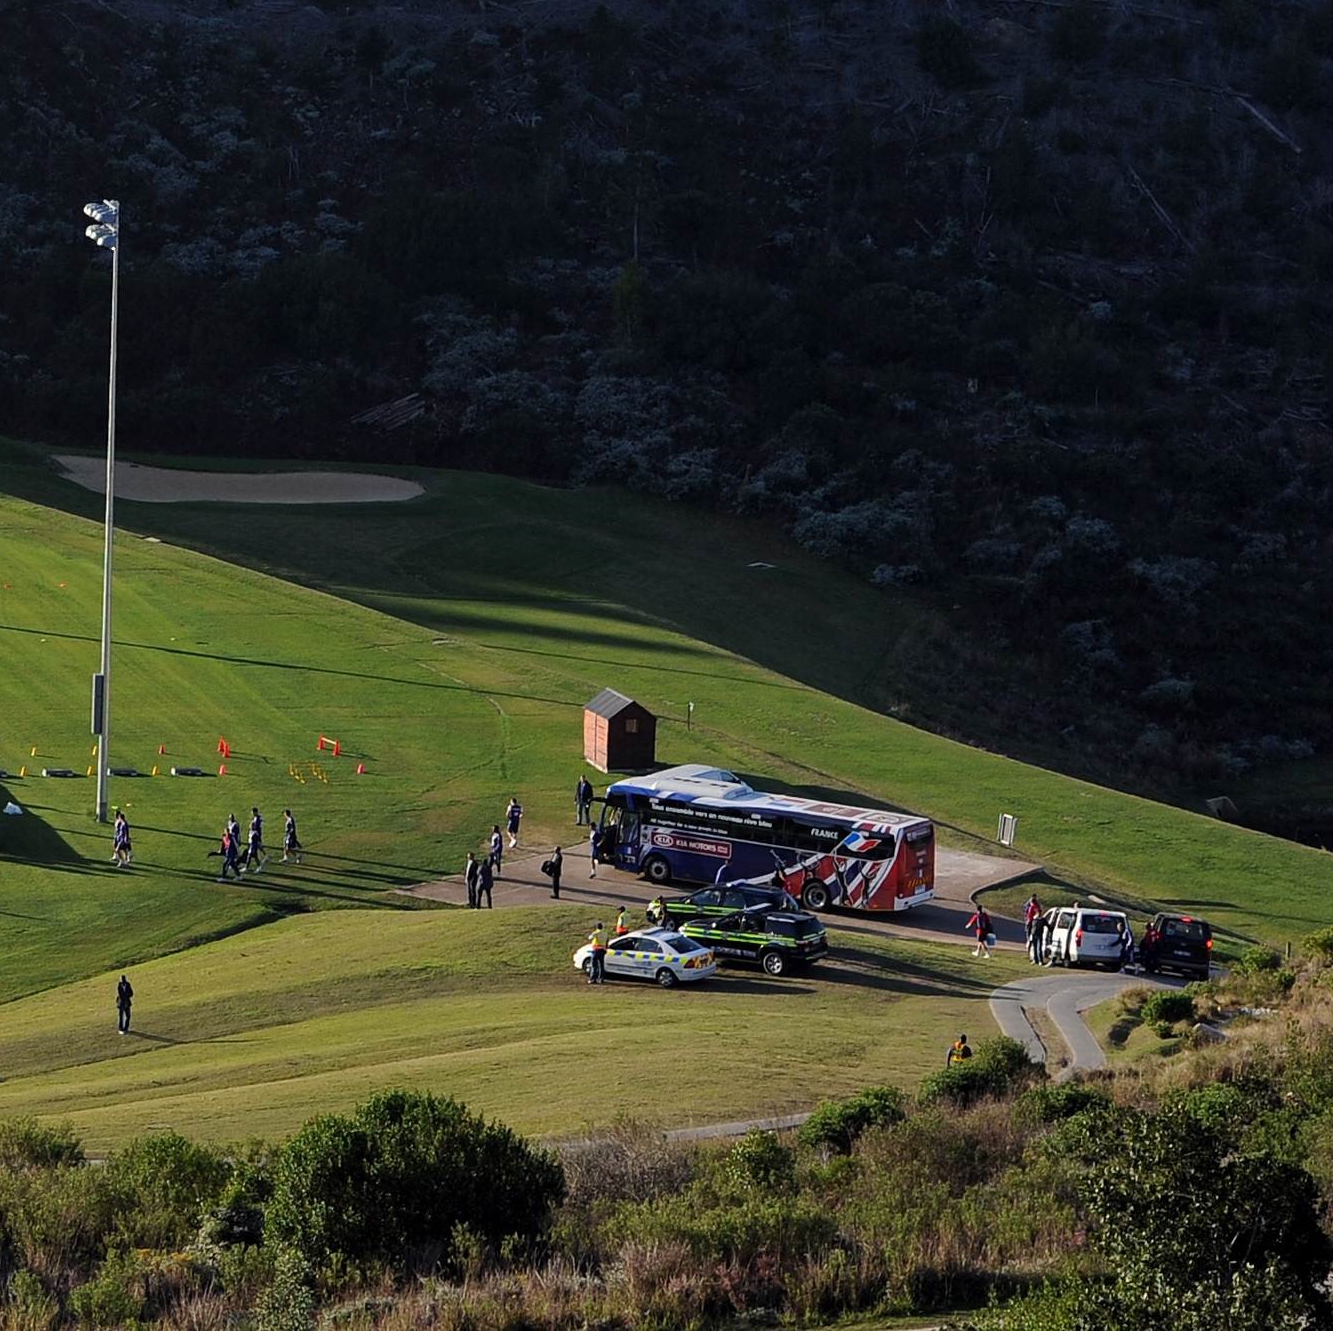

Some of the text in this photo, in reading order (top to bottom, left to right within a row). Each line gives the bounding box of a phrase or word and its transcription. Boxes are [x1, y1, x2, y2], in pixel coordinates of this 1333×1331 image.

[811, 828, 839, 840] FRANCE
[657, 836, 670, 844] KIA
[675, 839, 688, 847] KIA
[688, 841, 716, 852] MOTORS
